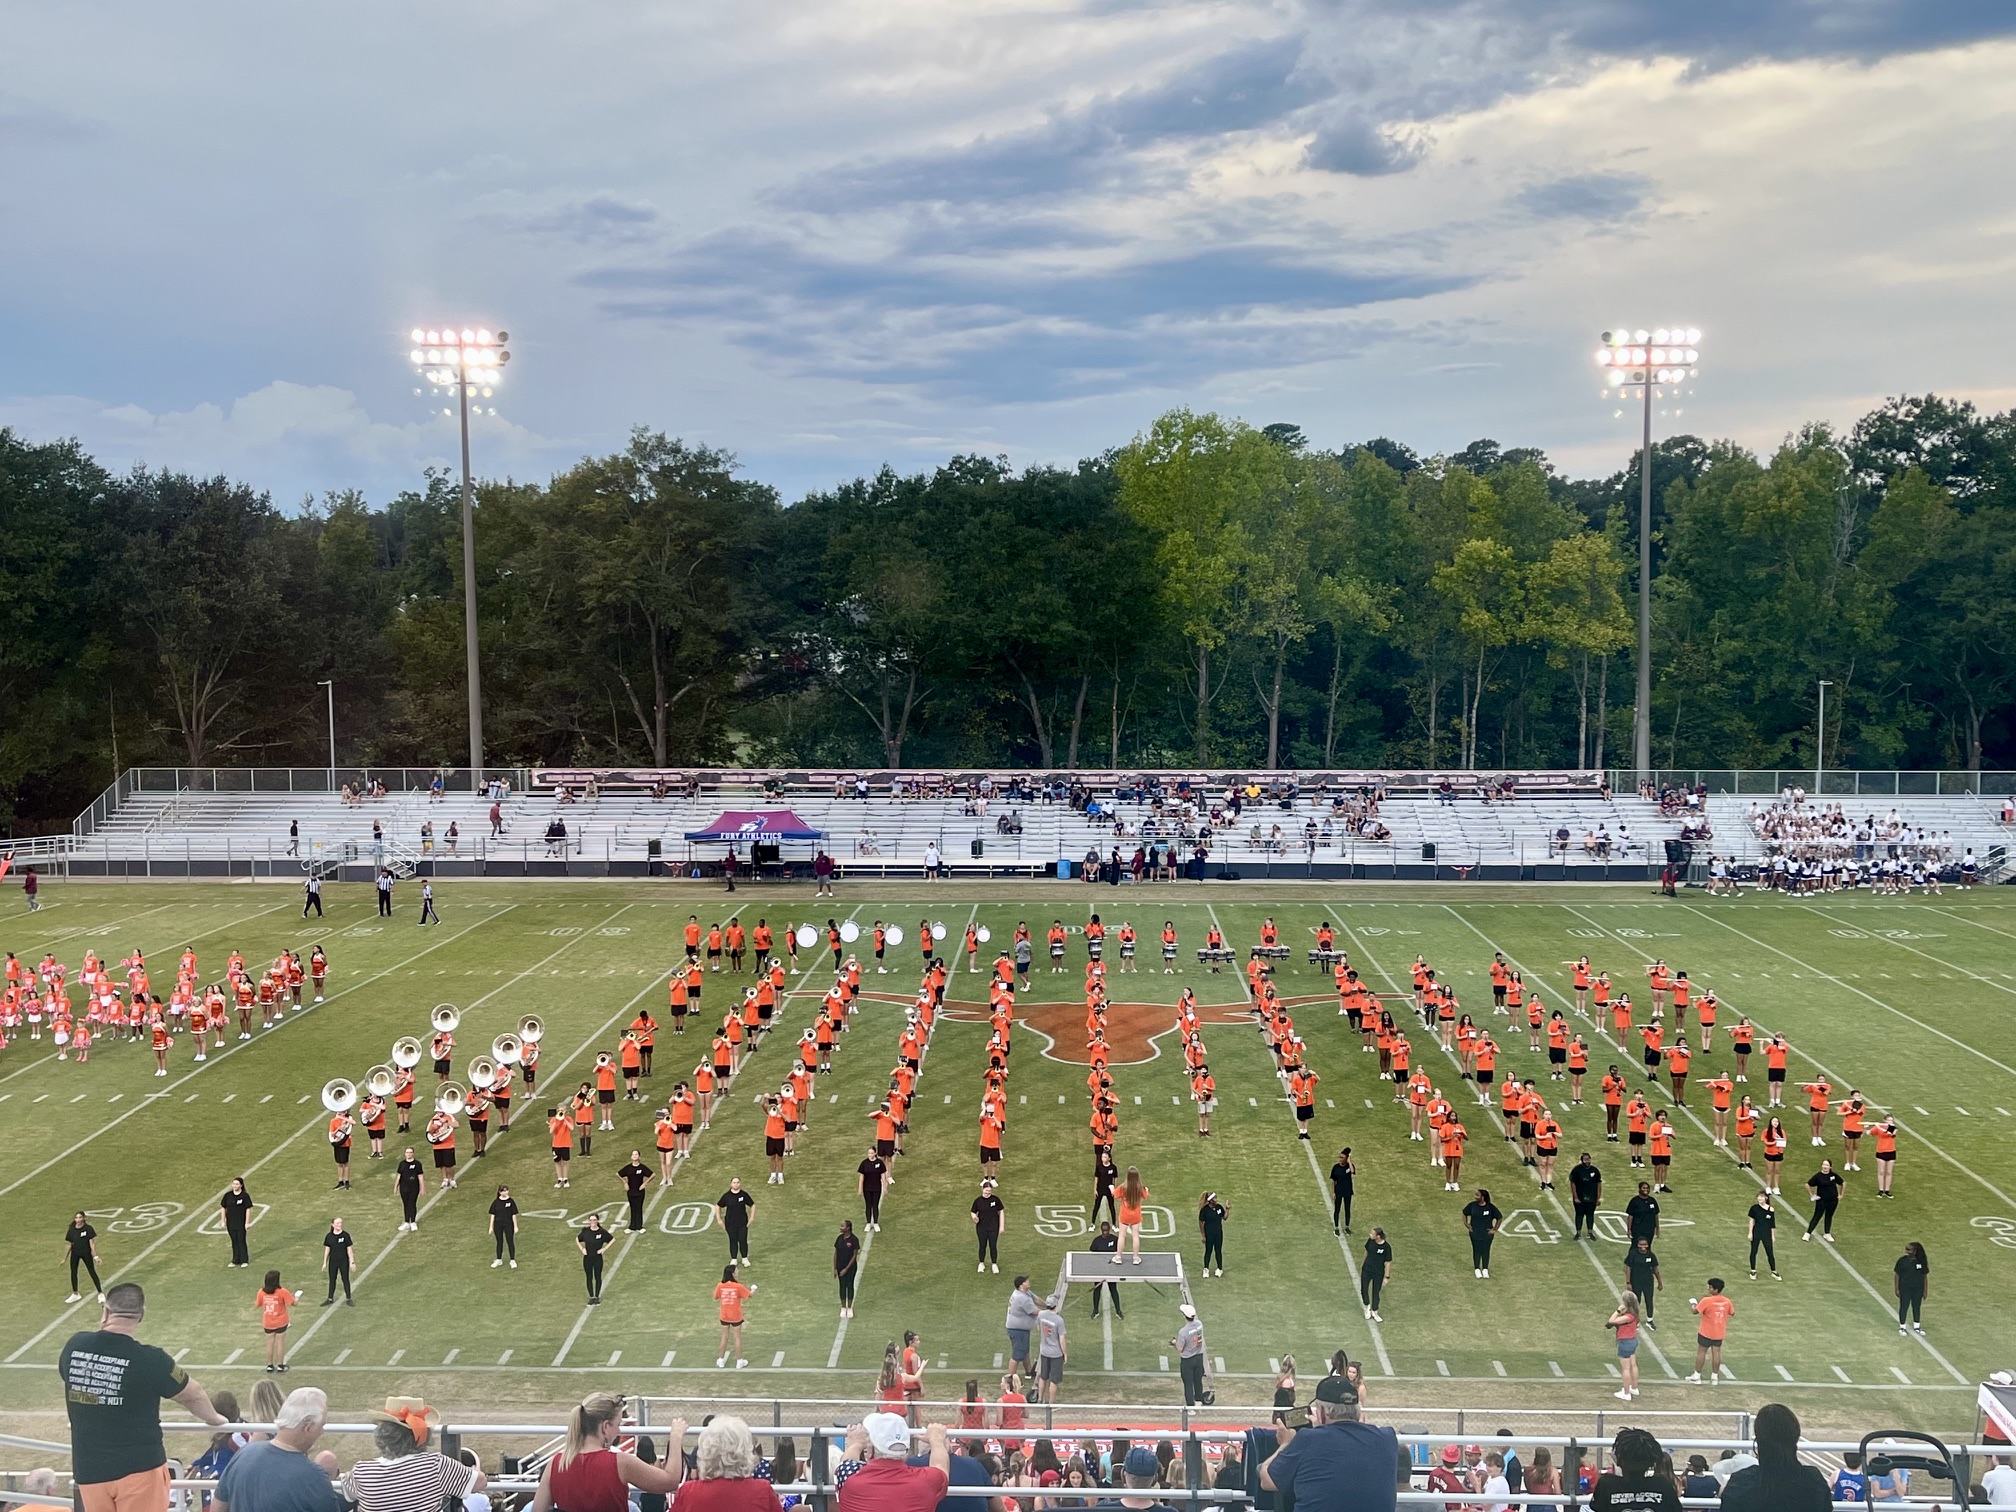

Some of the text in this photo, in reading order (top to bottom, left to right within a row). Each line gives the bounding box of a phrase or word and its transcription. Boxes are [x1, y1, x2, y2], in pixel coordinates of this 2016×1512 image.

[720, 832, 783, 840] FURY ATHLETICS
[98, 1355, 130, 1367] ACCEPTABLE
[93, 1363, 125, 1375] ACCEPTABLE
[107, 1396, 124, 1406] NOT
